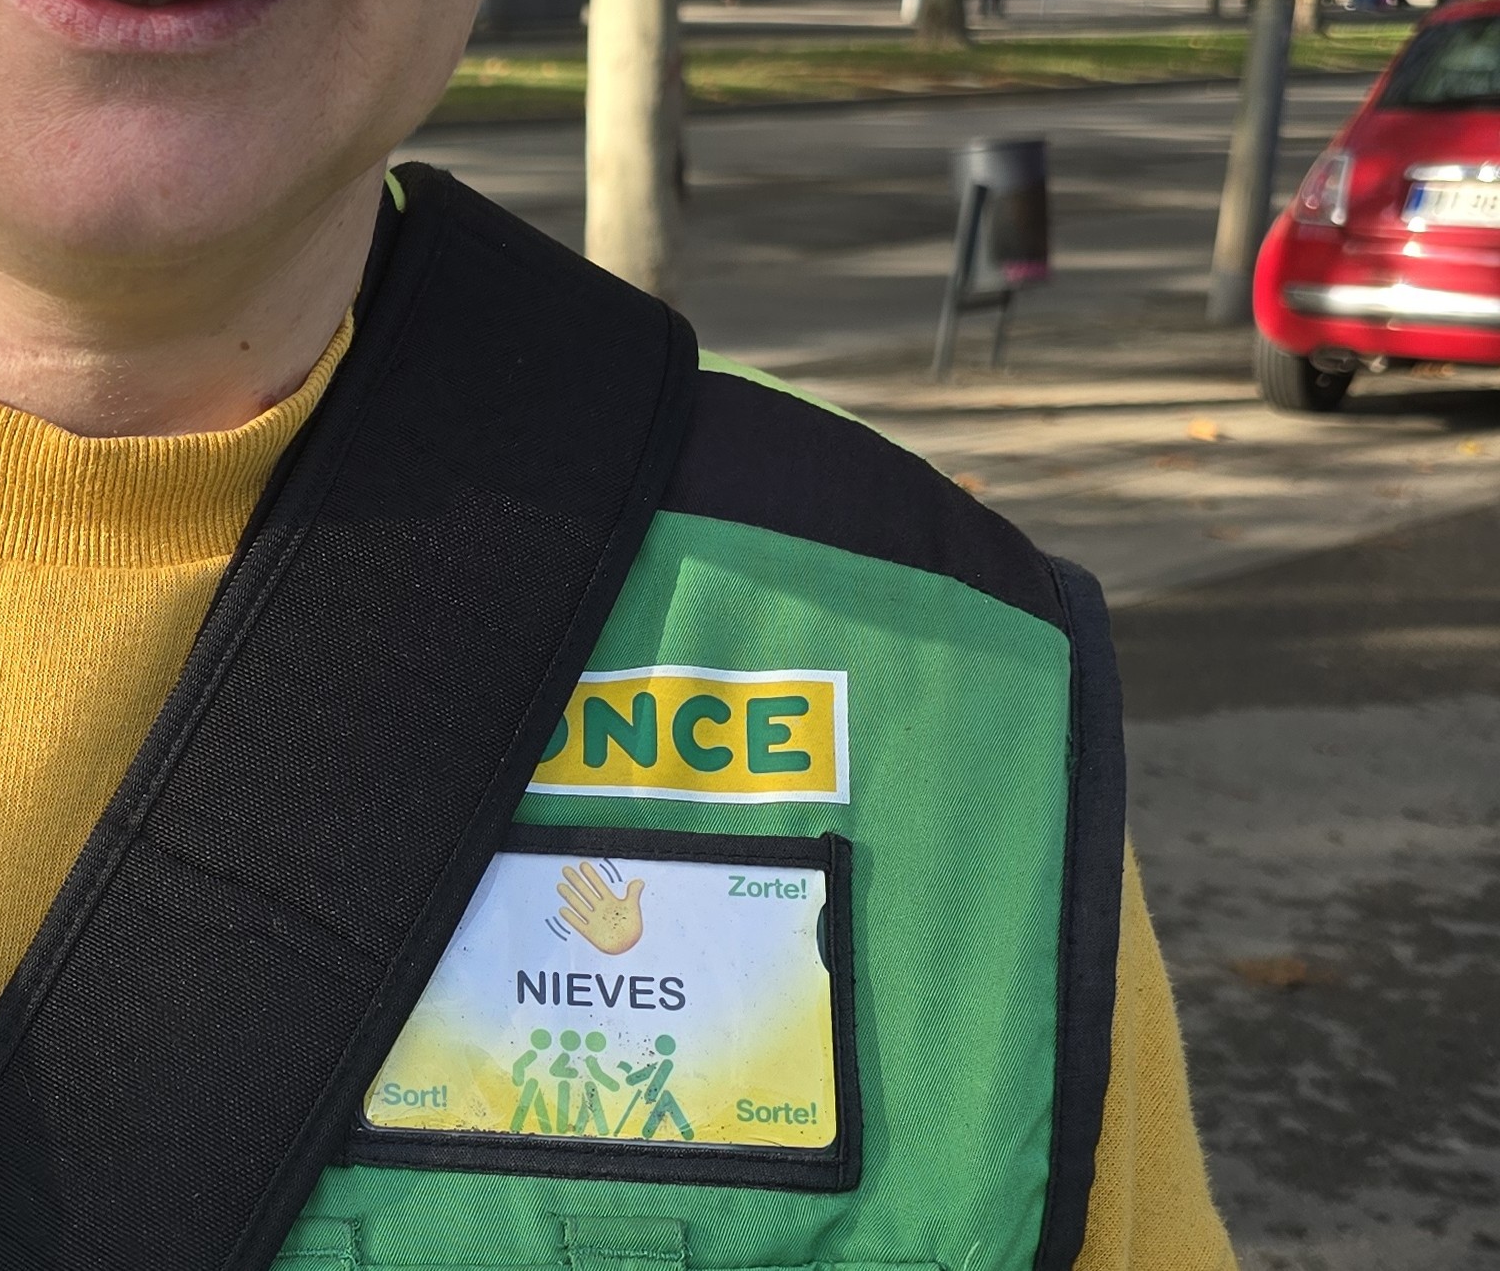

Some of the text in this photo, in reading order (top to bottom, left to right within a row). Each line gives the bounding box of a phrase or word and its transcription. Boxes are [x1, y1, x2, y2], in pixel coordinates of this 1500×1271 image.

[727, 874, 808, 900] Zorte!
[515, 969, 687, 1011] NIEVES
[381, 1082, 449, 1109] Sort!
[735, 1097, 818, 1126] Sorte!
